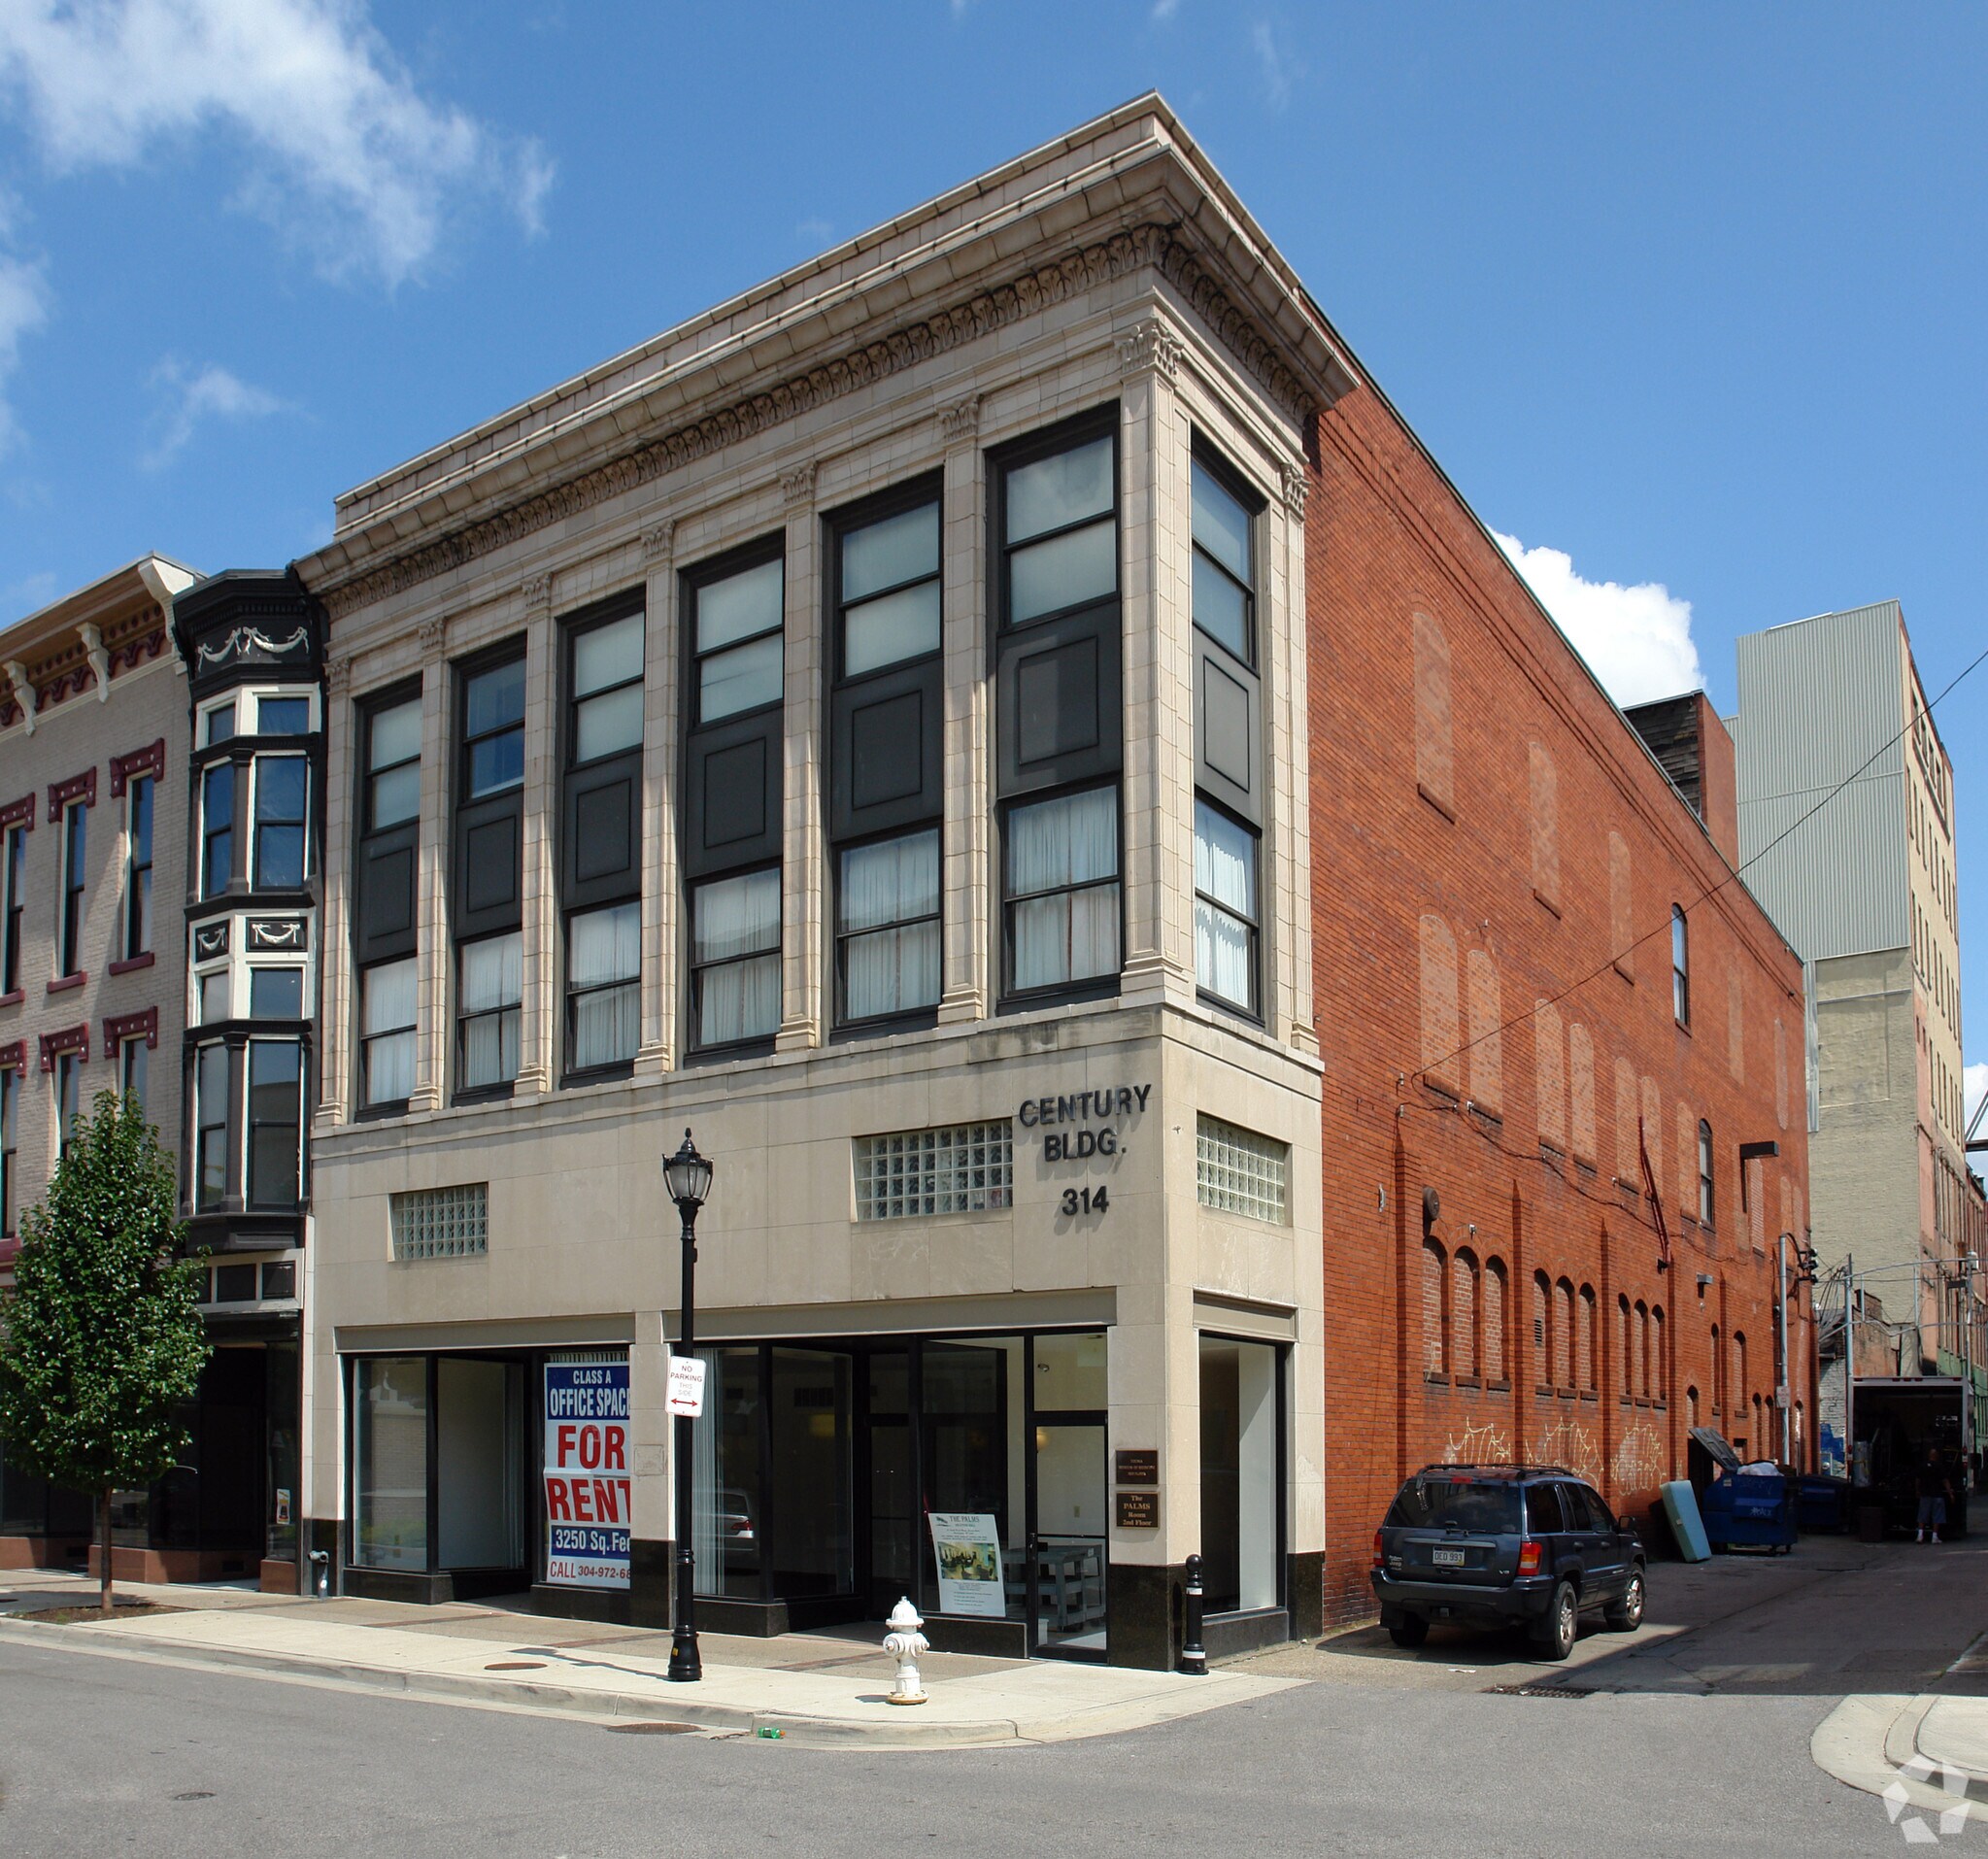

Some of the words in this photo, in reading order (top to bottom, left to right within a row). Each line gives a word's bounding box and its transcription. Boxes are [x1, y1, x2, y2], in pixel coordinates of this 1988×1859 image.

[1020, 1084, 1151, 1127] CENTURY
[1044, 1128, 1127, 1162] BLDG.
[1062, 1186, 1109, 1215] 314
[573, 1370, 603, 1384] CLASS
[605, 1370, 612, 1384] A
[671, 1372, 703, 1382] PARKING
[550, 1388, 594, 1416] OFFICE
[557, 1425, 626, 1470] FOR
[547, 1478, 630, 1524] RENT
[556, 1529, 587, 1549] 3250
[590, 1531, 610, 1555] Sq.
[551, 1561, 576, 1578] CALL
